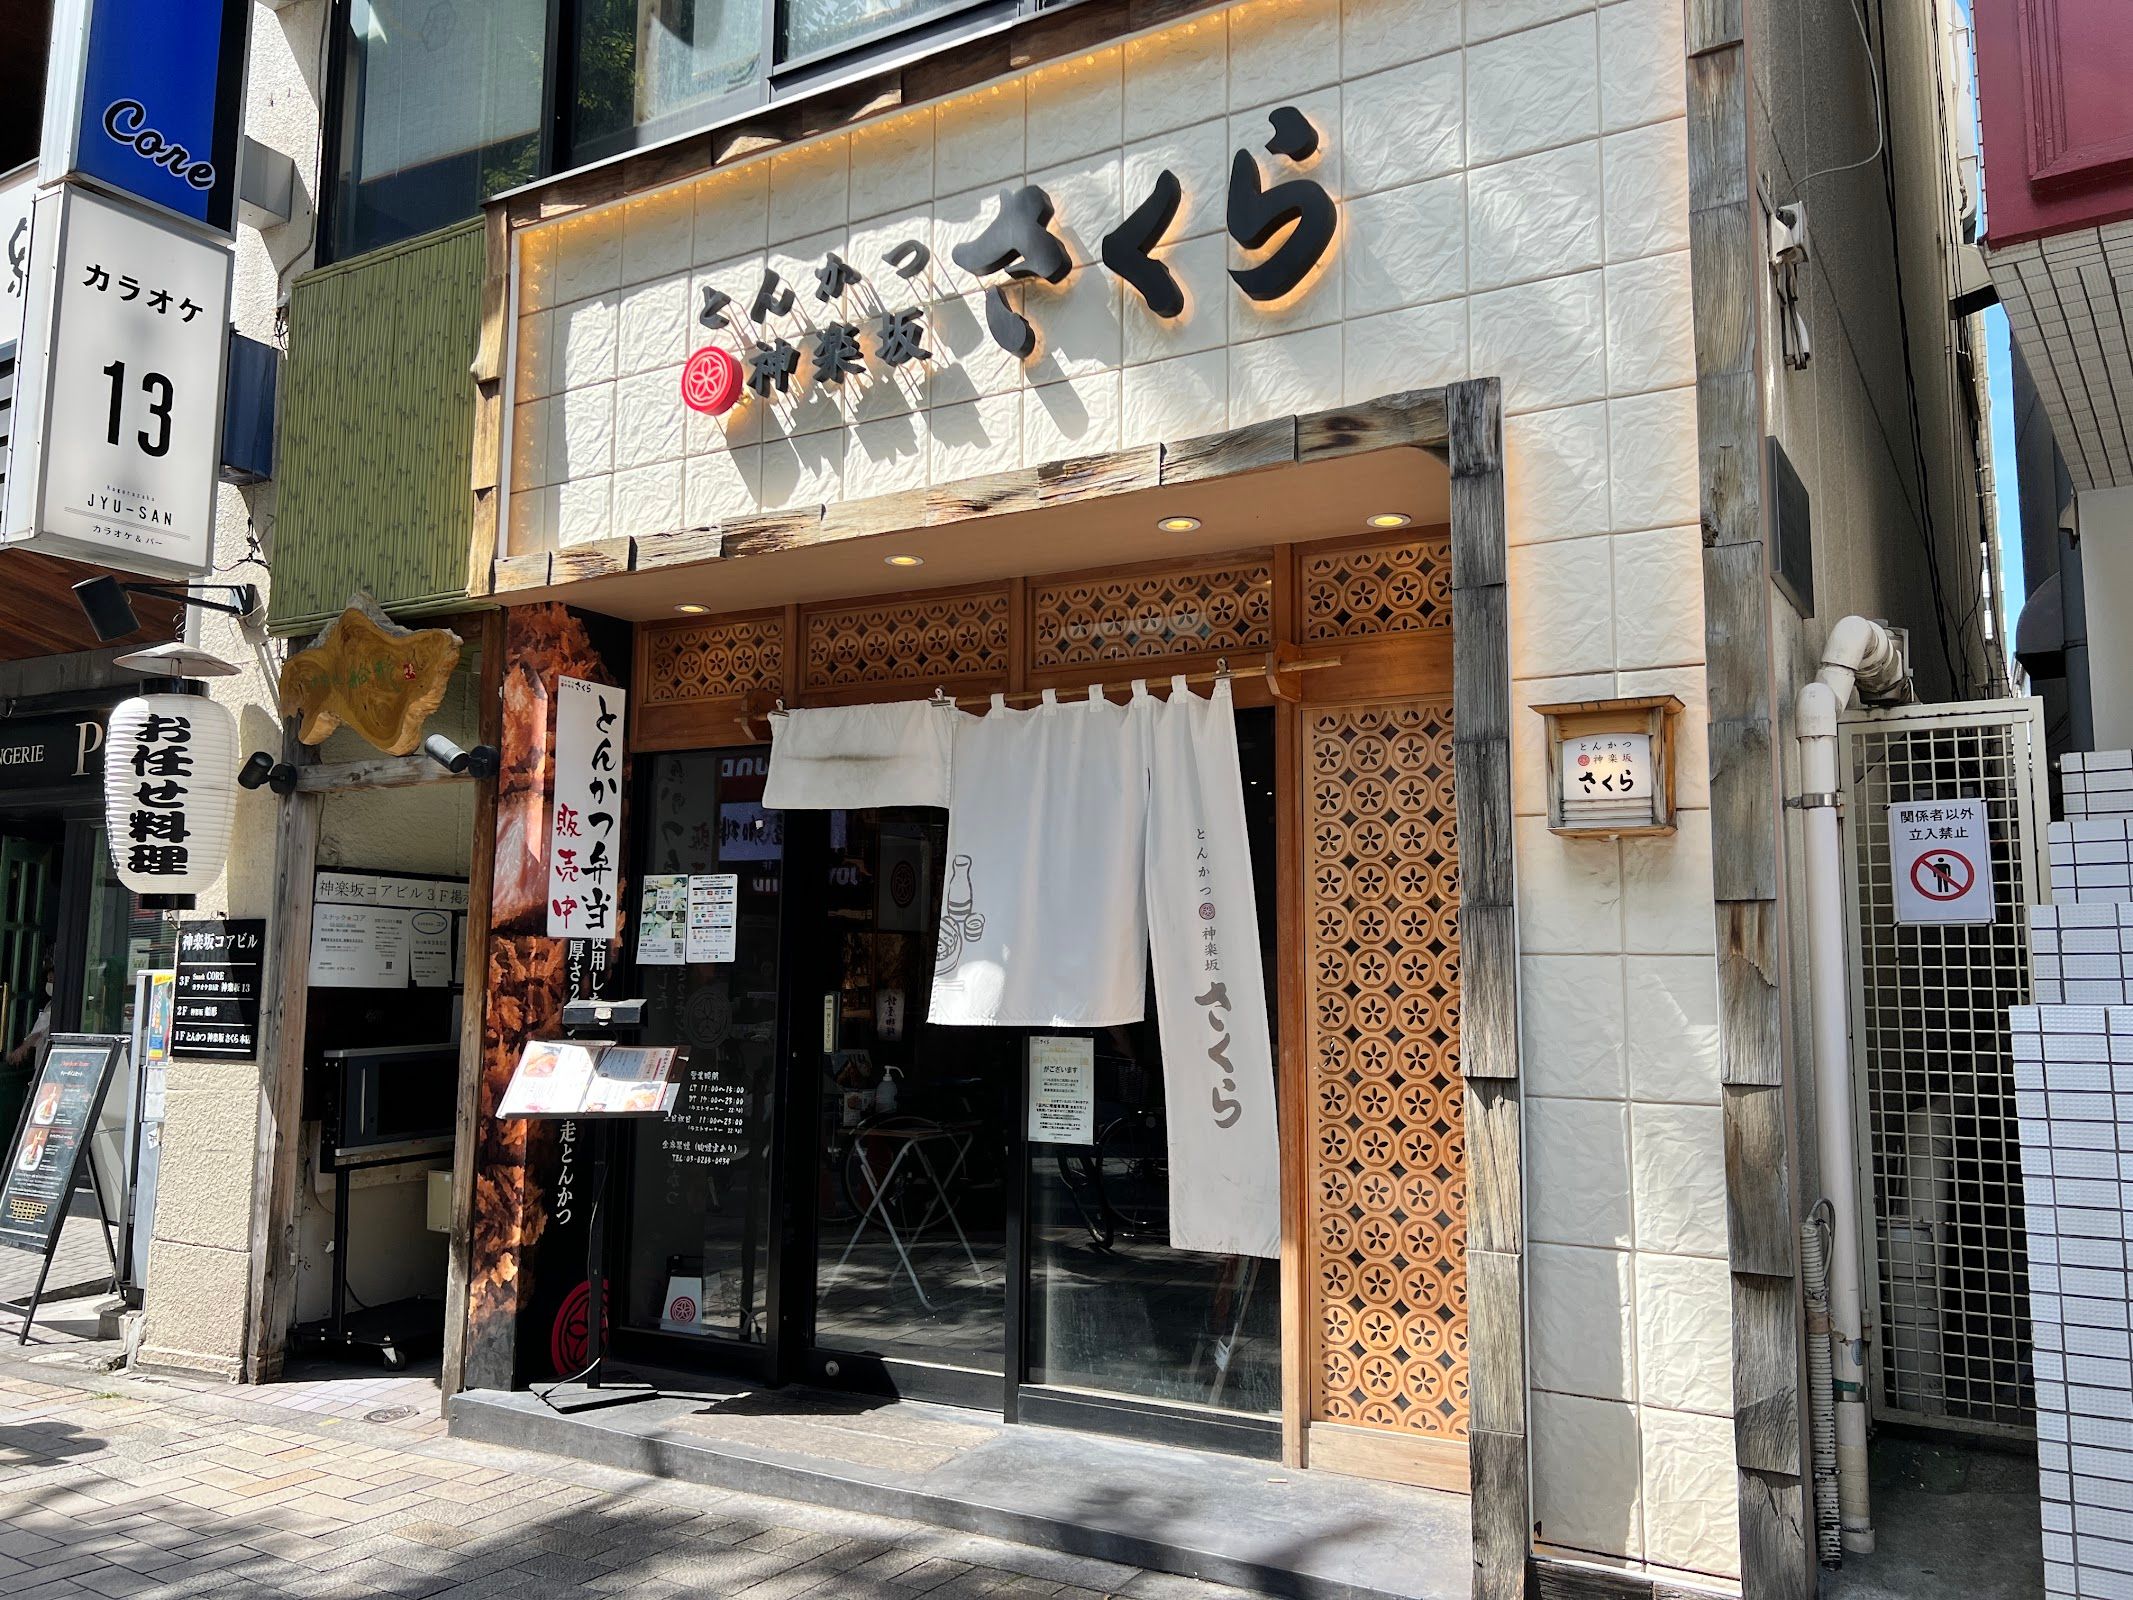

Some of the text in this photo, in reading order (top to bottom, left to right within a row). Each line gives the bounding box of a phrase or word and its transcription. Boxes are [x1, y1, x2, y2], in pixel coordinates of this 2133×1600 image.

[103, 99, 216, 190] Core
[952, 106, 1338, 360] さくら
[83, 264, 205, 324] カラオケ
[698, 239, 930, 330] とんかつ
[748, 307, 932, 398] 神楽坂
[103, 360, 175, 458] 13
[88, 494, 172, 526] JYU-SAN
[71, 722, 104, 776] P
[1580, 741, 1632, 751] とんかつ
[1594, 753, 1633, 764] 神楽坂
[128, 713, 192, 876] お任せ料理
[1579, 769, 1634, 793] さくら
[580, 695, 617, 930] とんかつ弁当
[1900, 807, 1974, 823] 関係者以外
[1909, 827, 1969, 840] 立入禁止
[553, 803, 582, 929] 販売中
[1197, 828, 1211, 896] とんかつ
[182, 933, 258, 950] 神楽坂コアビル
[1202, 926, 1220, 971] 神楽坂
[179, 975, 190, 986] 3F
[206, 971, 225, 981] CORE
[241, 984, 251, 992] 13
[177, 1006, 188, 1016] 2F
[175, 1031, 186, 1041] 1F
[1195, 982, 1242, 1129] さくら
